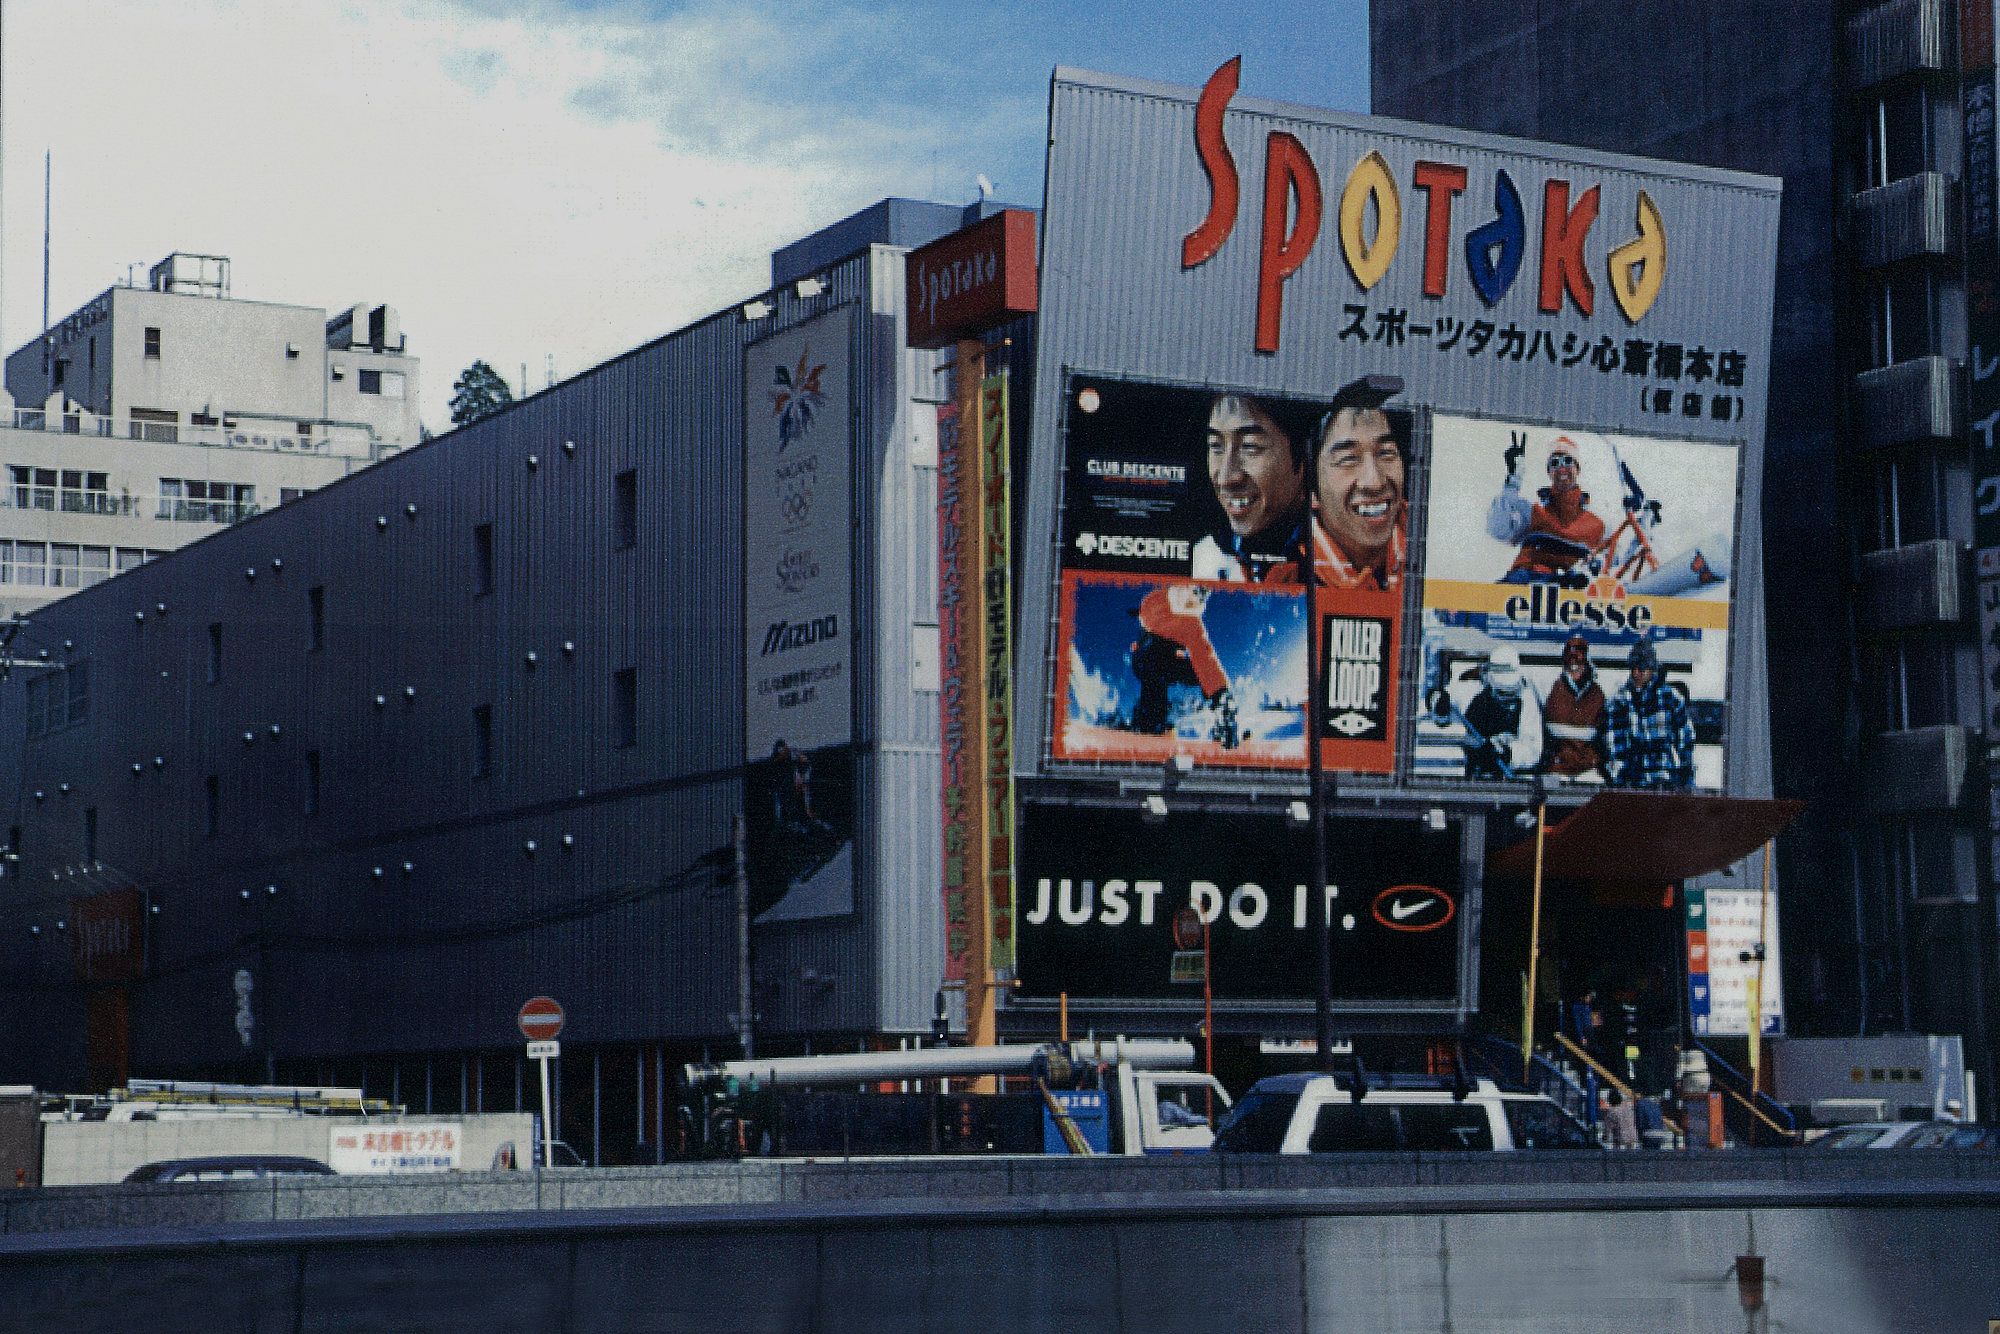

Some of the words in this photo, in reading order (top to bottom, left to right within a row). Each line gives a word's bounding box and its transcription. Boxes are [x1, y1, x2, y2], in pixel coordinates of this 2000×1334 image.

[1087, 460, 1119, 476] CLUB
[1098, 535, 1189, 560] DESCENTE
[1506, 583, 1651, 629] ellesse
[1331, 619, 1381, 661] KILLER
[1026, 878, 1163, 925] JUST
[1190, 880, 1270, 929] DO
